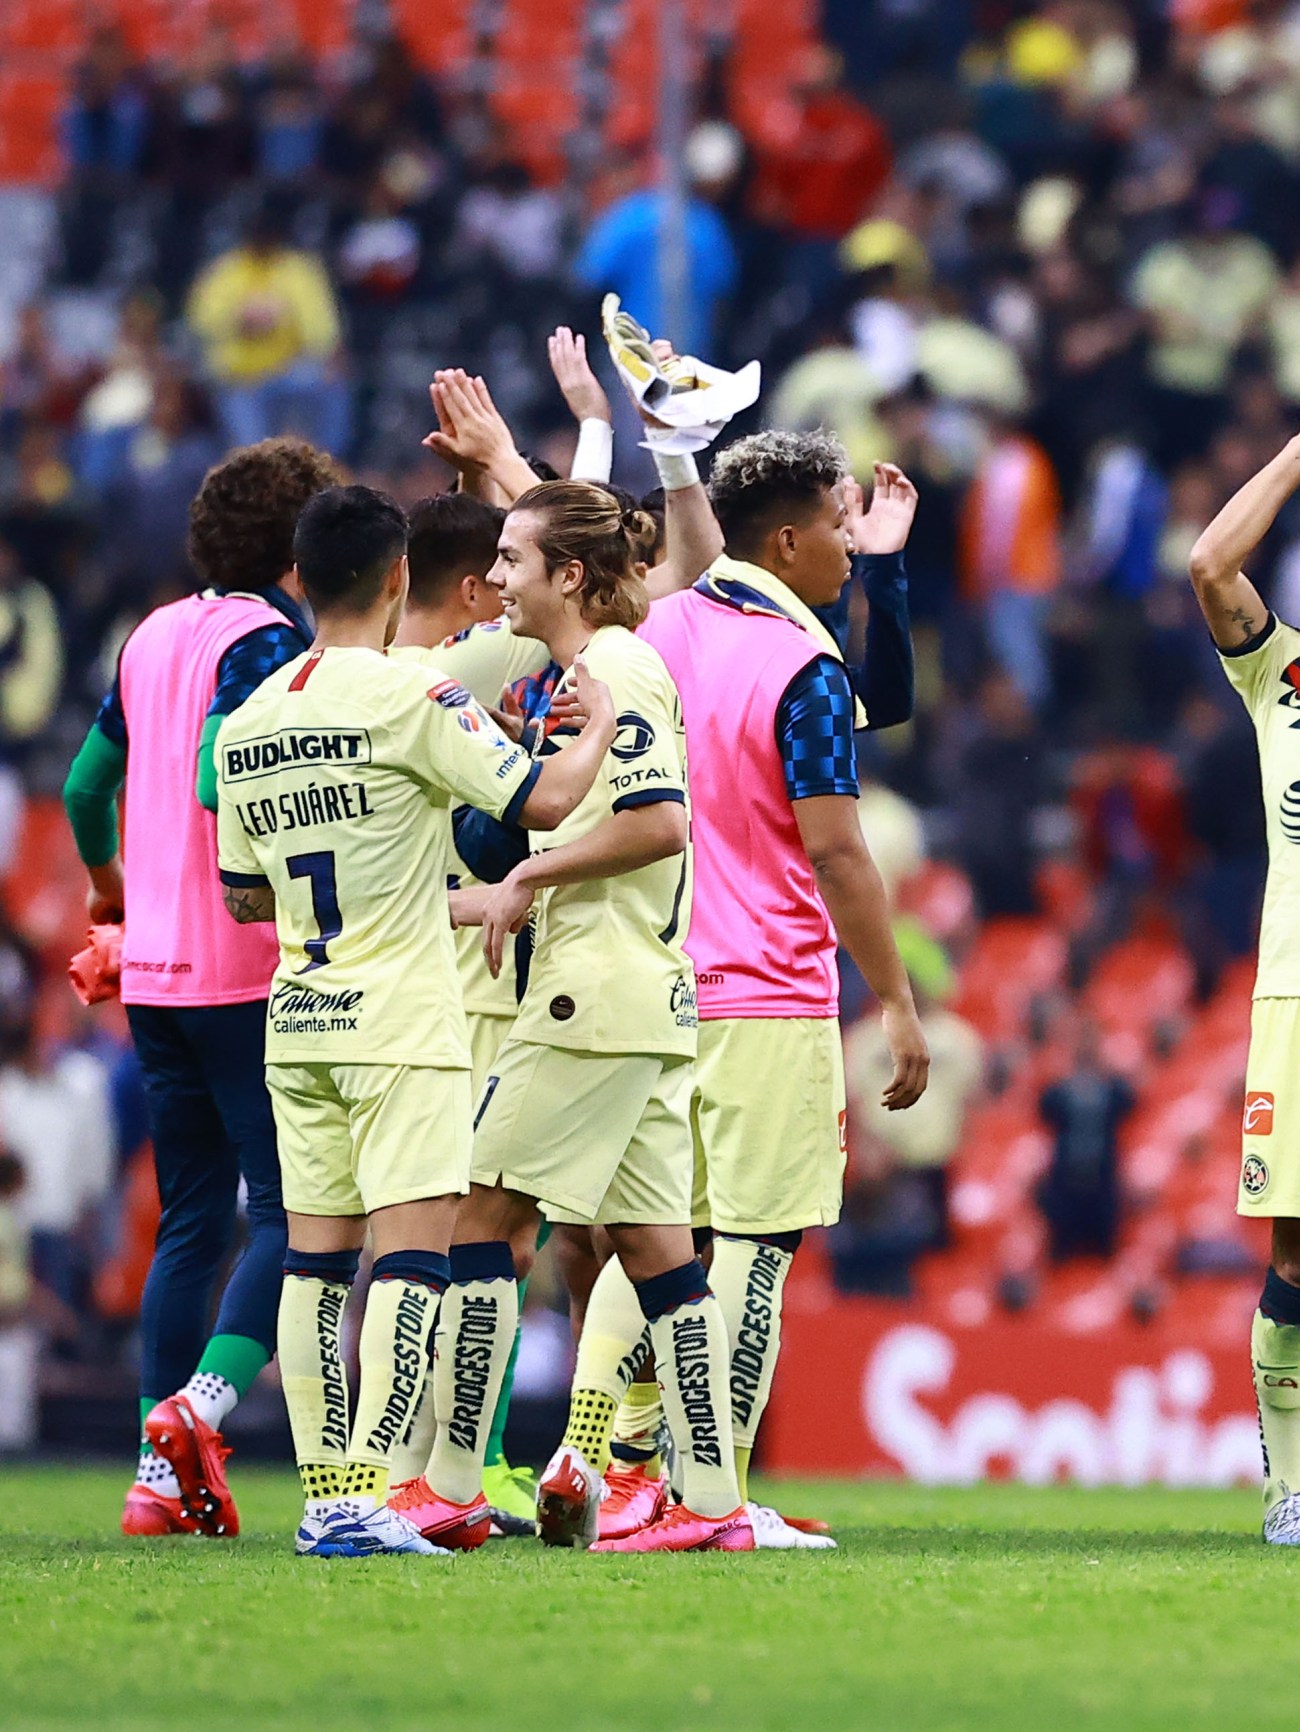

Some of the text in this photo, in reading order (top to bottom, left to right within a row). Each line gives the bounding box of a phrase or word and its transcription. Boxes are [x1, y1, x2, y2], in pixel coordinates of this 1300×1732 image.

[236, 782, 375, 836] LEO SUÁREZ
[496, 748, 526, 779] inter
[609, 768, 673, 791] TOTAL
[285, 850, 343, 976] 7
[270, 982, 364, 1020] Caliente
[274, 1016, 358, 1033] caliente.mx
[317, 1287, 346, 1454] BRIDGESTONE
[367, 1287, 429, 1455] BRIDGESTONE
[449, 1295, 498, 1453] BRIDGESTONE
[673, 1315, 723, 1468] BRIDGESTONE
[730, 1245, 782, 1429] BRIDGESTONE
